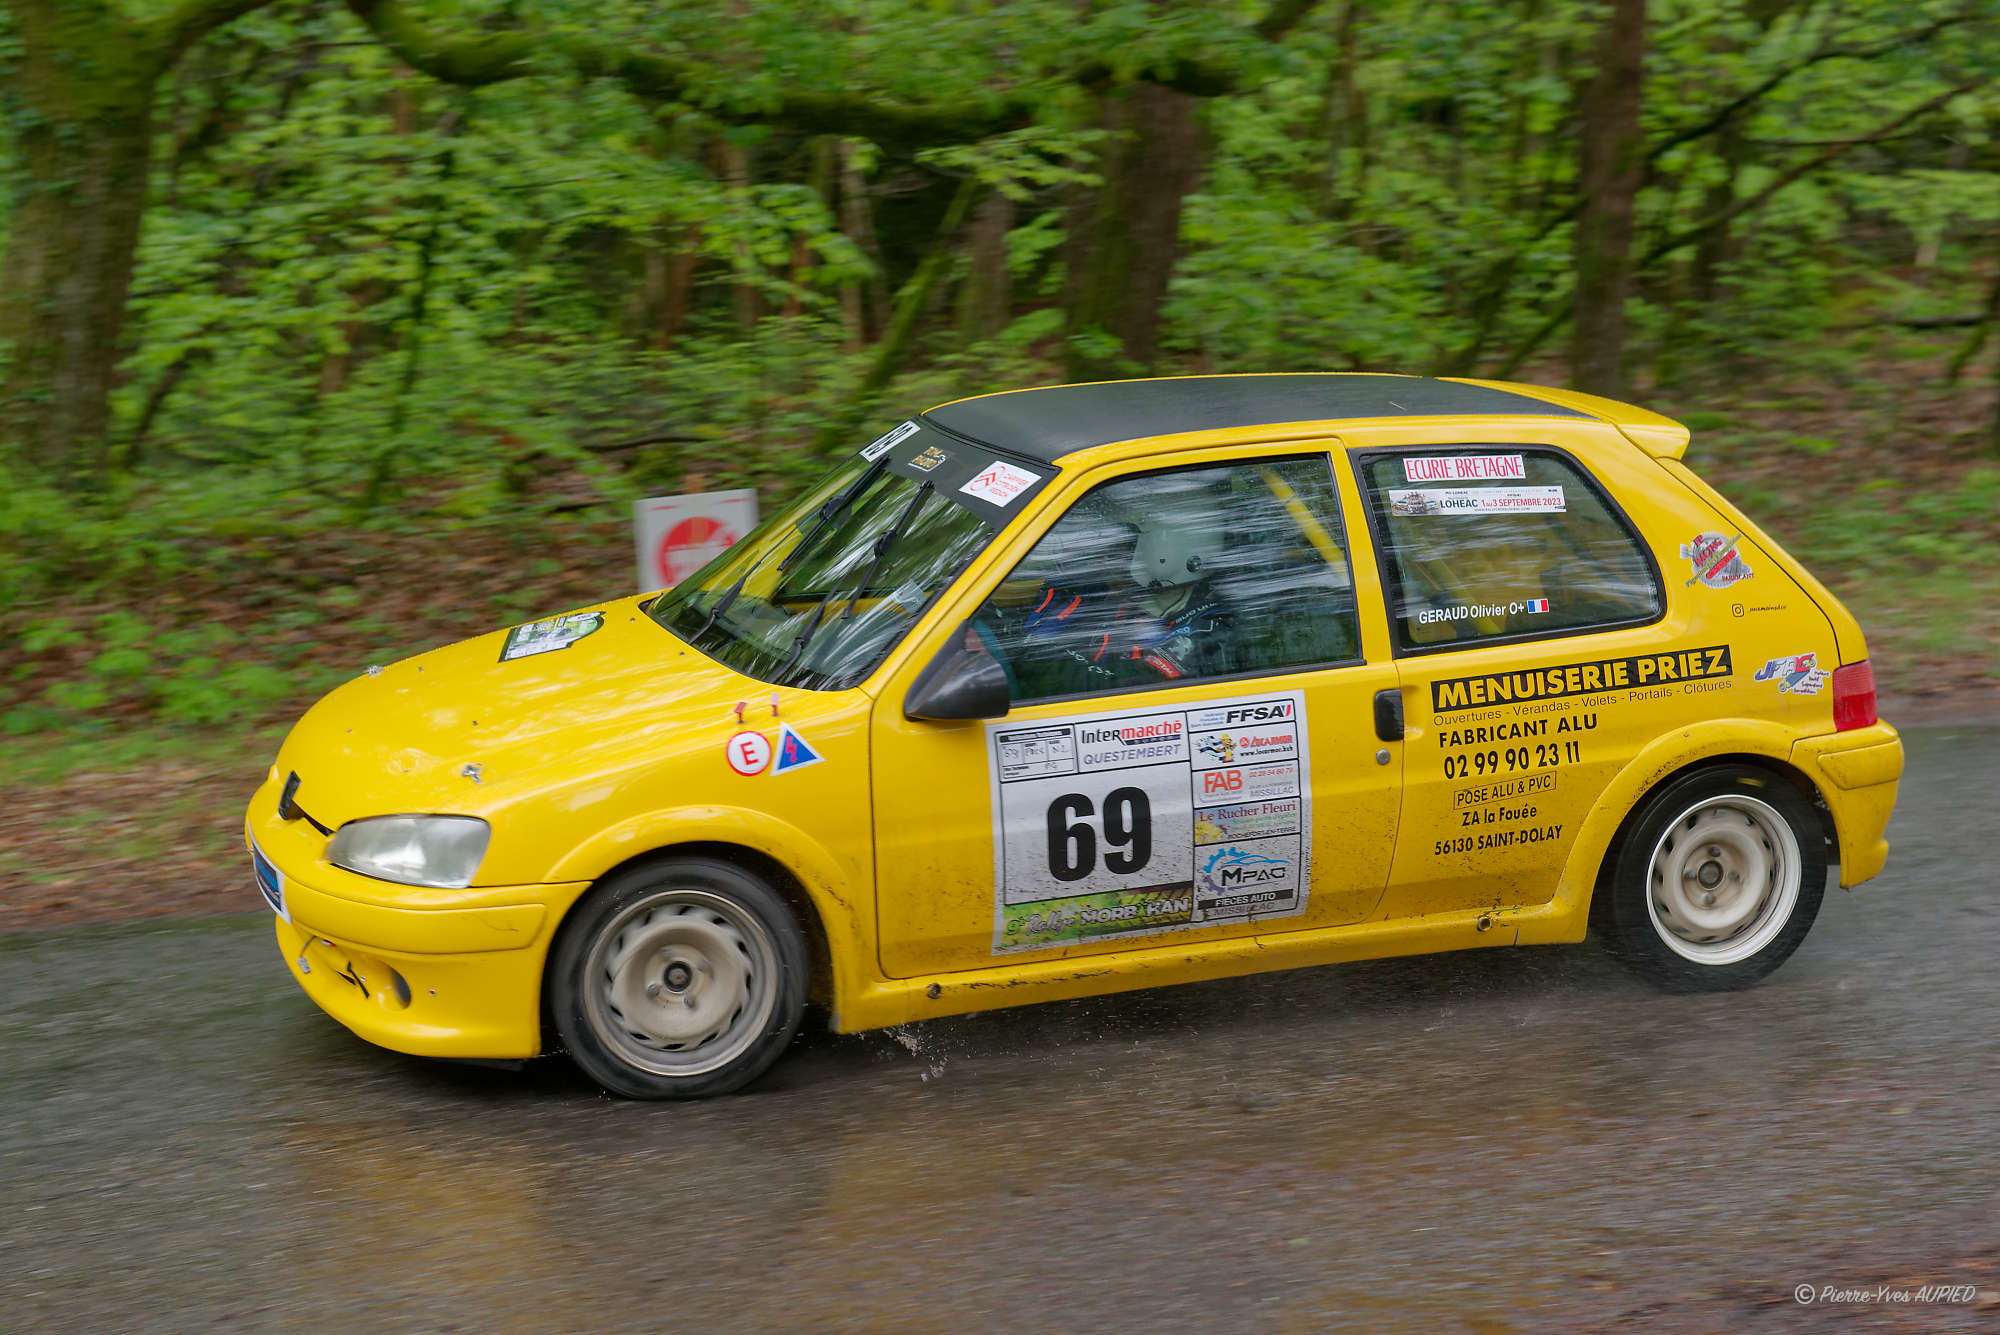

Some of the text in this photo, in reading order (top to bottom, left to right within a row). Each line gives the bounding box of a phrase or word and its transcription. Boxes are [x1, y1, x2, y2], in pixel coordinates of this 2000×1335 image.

[1406, 456, 1524, 480] ECURIE BRETAGNE
[1440, 498, 1479, 509] LOHEAC
[1499, 498, 1542, 507] SEPTEMBRE
[1543, 496, 1562, 506] 2023
[1419, 606, 1469, 624] GERAUD
[1470, 603, 1507, 618] Olivier
[1438, 648, 1728, 709] MENUISERIE PRIEZ
[1226, 704, 1286, 723] FFSA
[1433, 710, 1502, 726] Ouvertures
[1513, 700, 1570, 716] Vérandas
[1581, 694, 1617, 707] Volets
[1629, 687, 1673, 702] Portails
[1684, 679, 1732, 695] Clôtures
[1439, 713, 1598, 748] FABRICANT ALU
[740, 741, 760, 765] E
[1083, 744, 1182, 765] QUESTEMBERT
[1444, 740, 1580, 779] 02 99 90 23 11
[1204, 769, 1243, 793] FAB
[1457, 775, 1551, 806] POSE ALU & PVC
[1200, 811, 1215, 822] Le
[1217, 807, 1260, 820] Rucher
[1262, 800, 1296, 815] Fleuri
[1462, 803, 1537, 826] ZA la Fouée
[1047, 786, 1152, 882] 69
[1434, 824, 1563, 855] 56130 SAINT-DOLAY
[1250, 892, 1276, 903] AUTO
